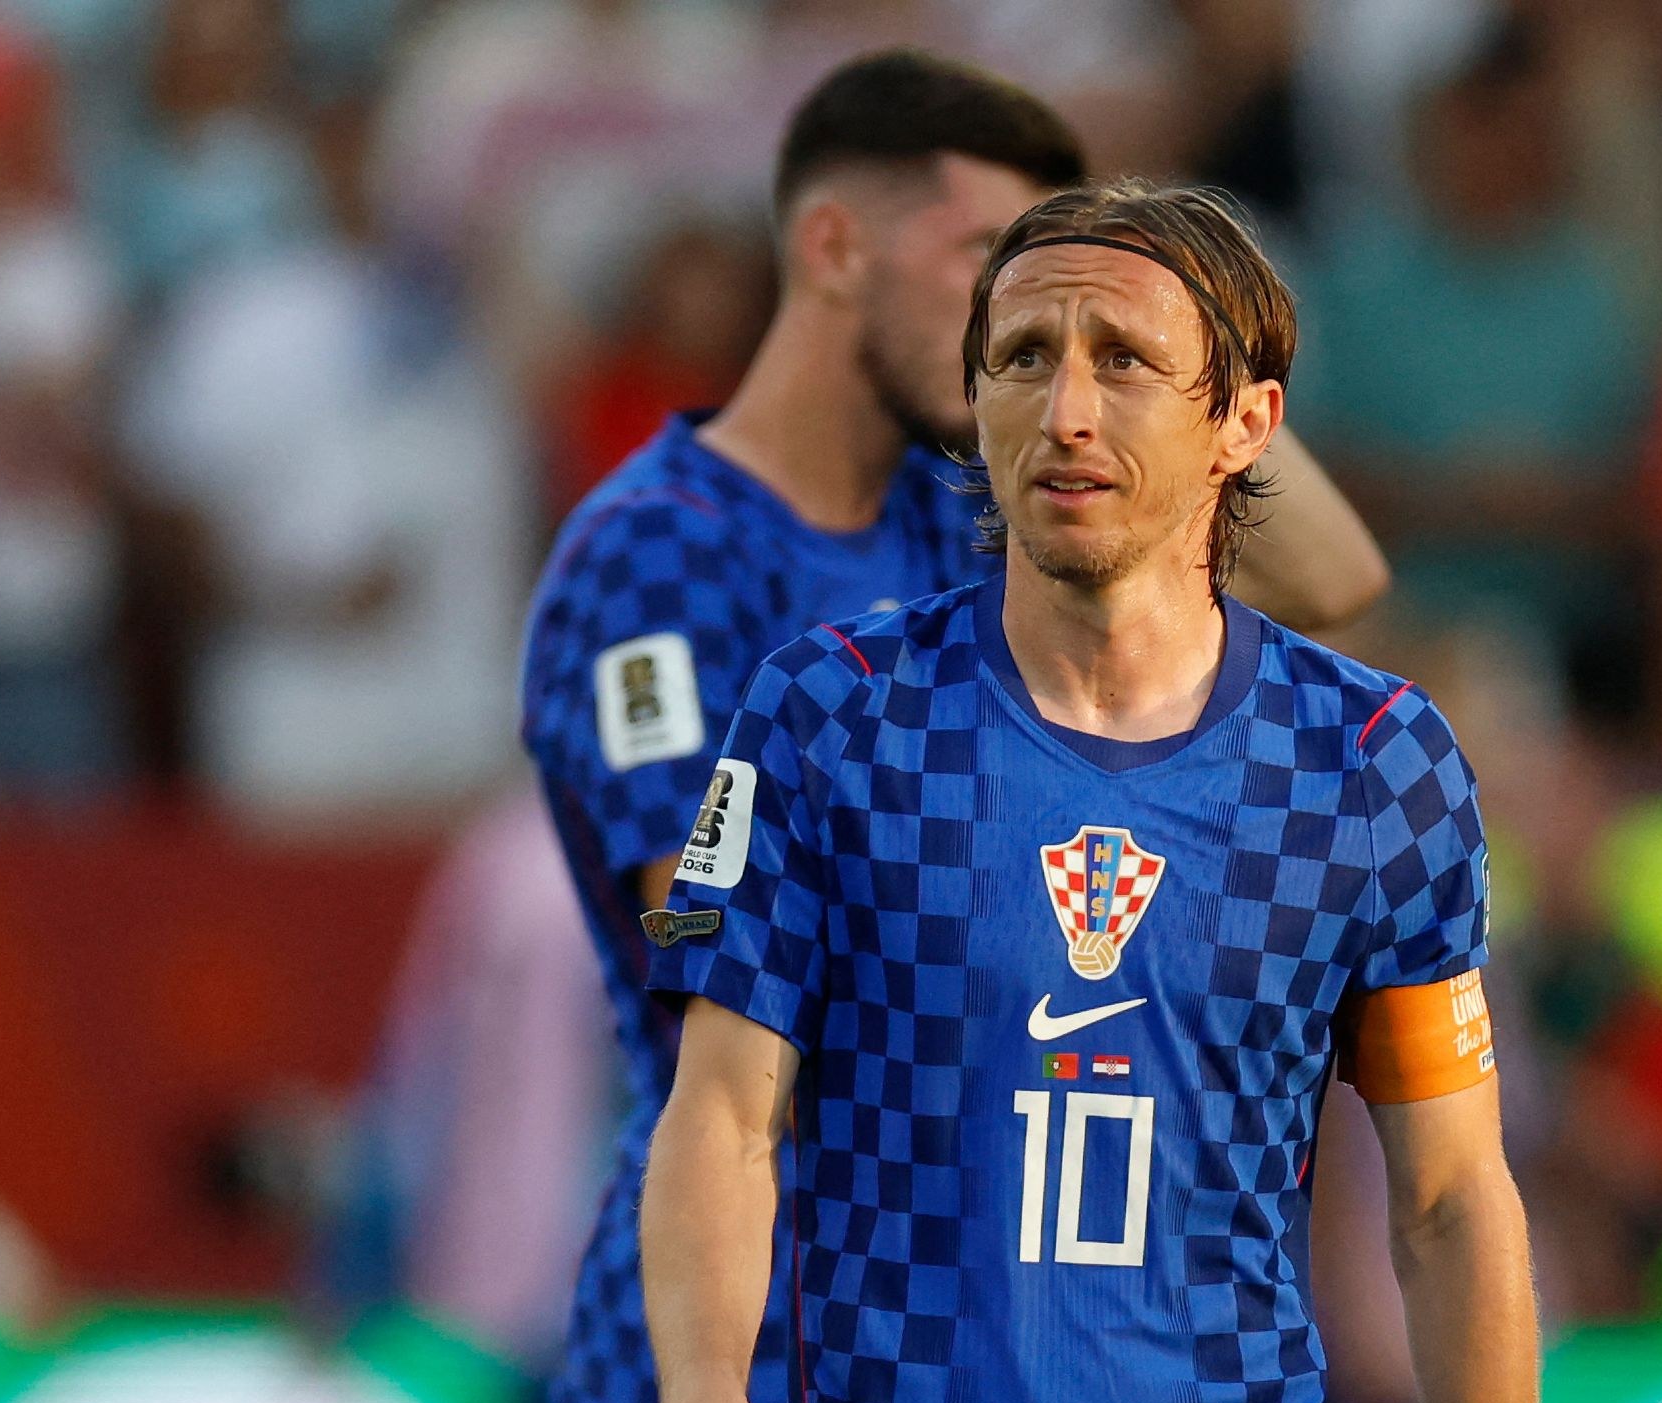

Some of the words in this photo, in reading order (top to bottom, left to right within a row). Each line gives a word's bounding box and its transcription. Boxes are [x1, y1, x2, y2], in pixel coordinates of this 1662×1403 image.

[702, 852, 717, 860] CUP
[1091, 843, 1113, 917] HNS
[1014, 1090, 1155, 1267] 10
